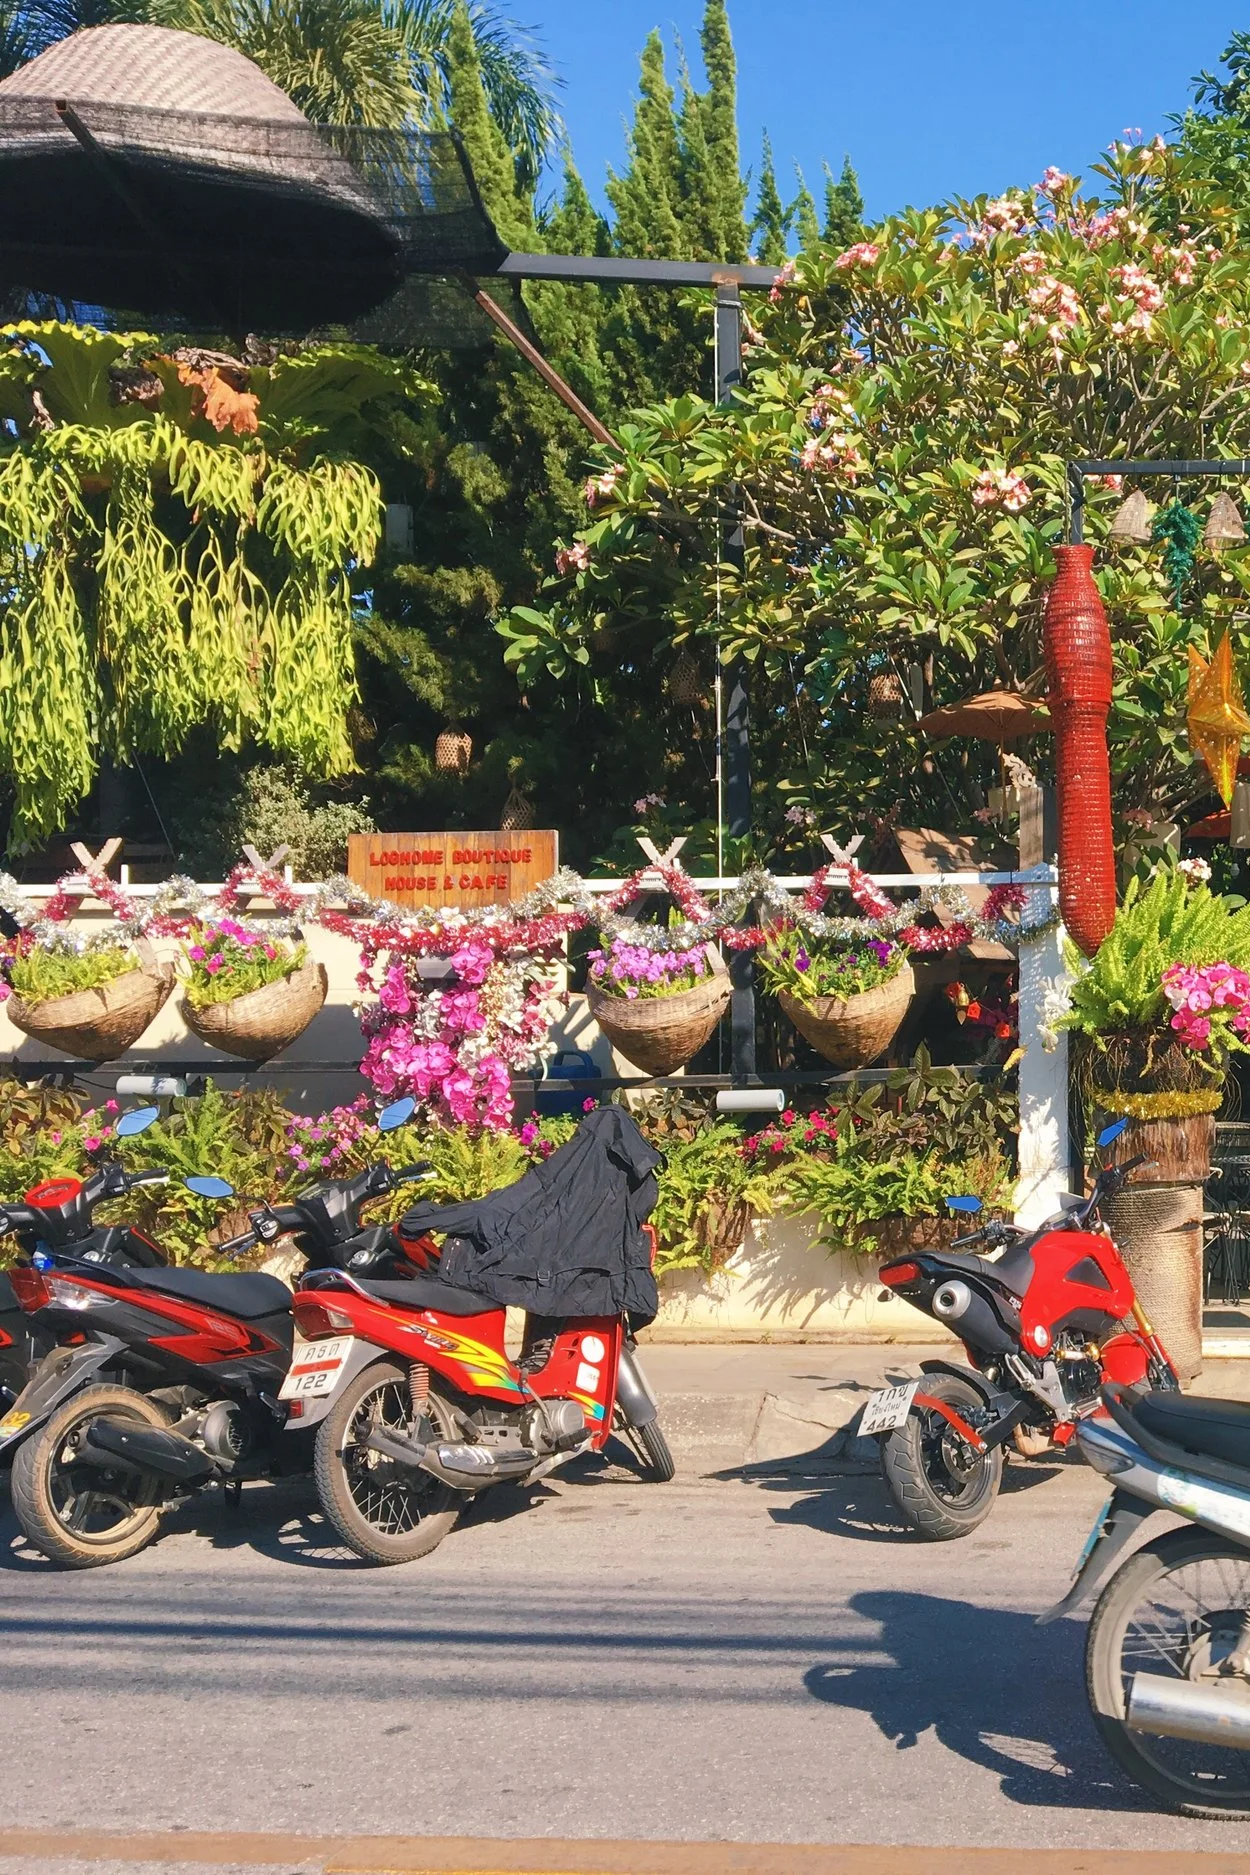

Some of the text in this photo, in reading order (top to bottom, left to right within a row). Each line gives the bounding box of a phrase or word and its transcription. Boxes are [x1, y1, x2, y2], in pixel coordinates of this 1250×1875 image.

[453, 848, 532, 865] BOUTIQUE
[385, 874, 508, 891] HOUSE & CAFE
[294, 1374, 328, 1391] 122
[866, 1415, 897, 1432] 442
